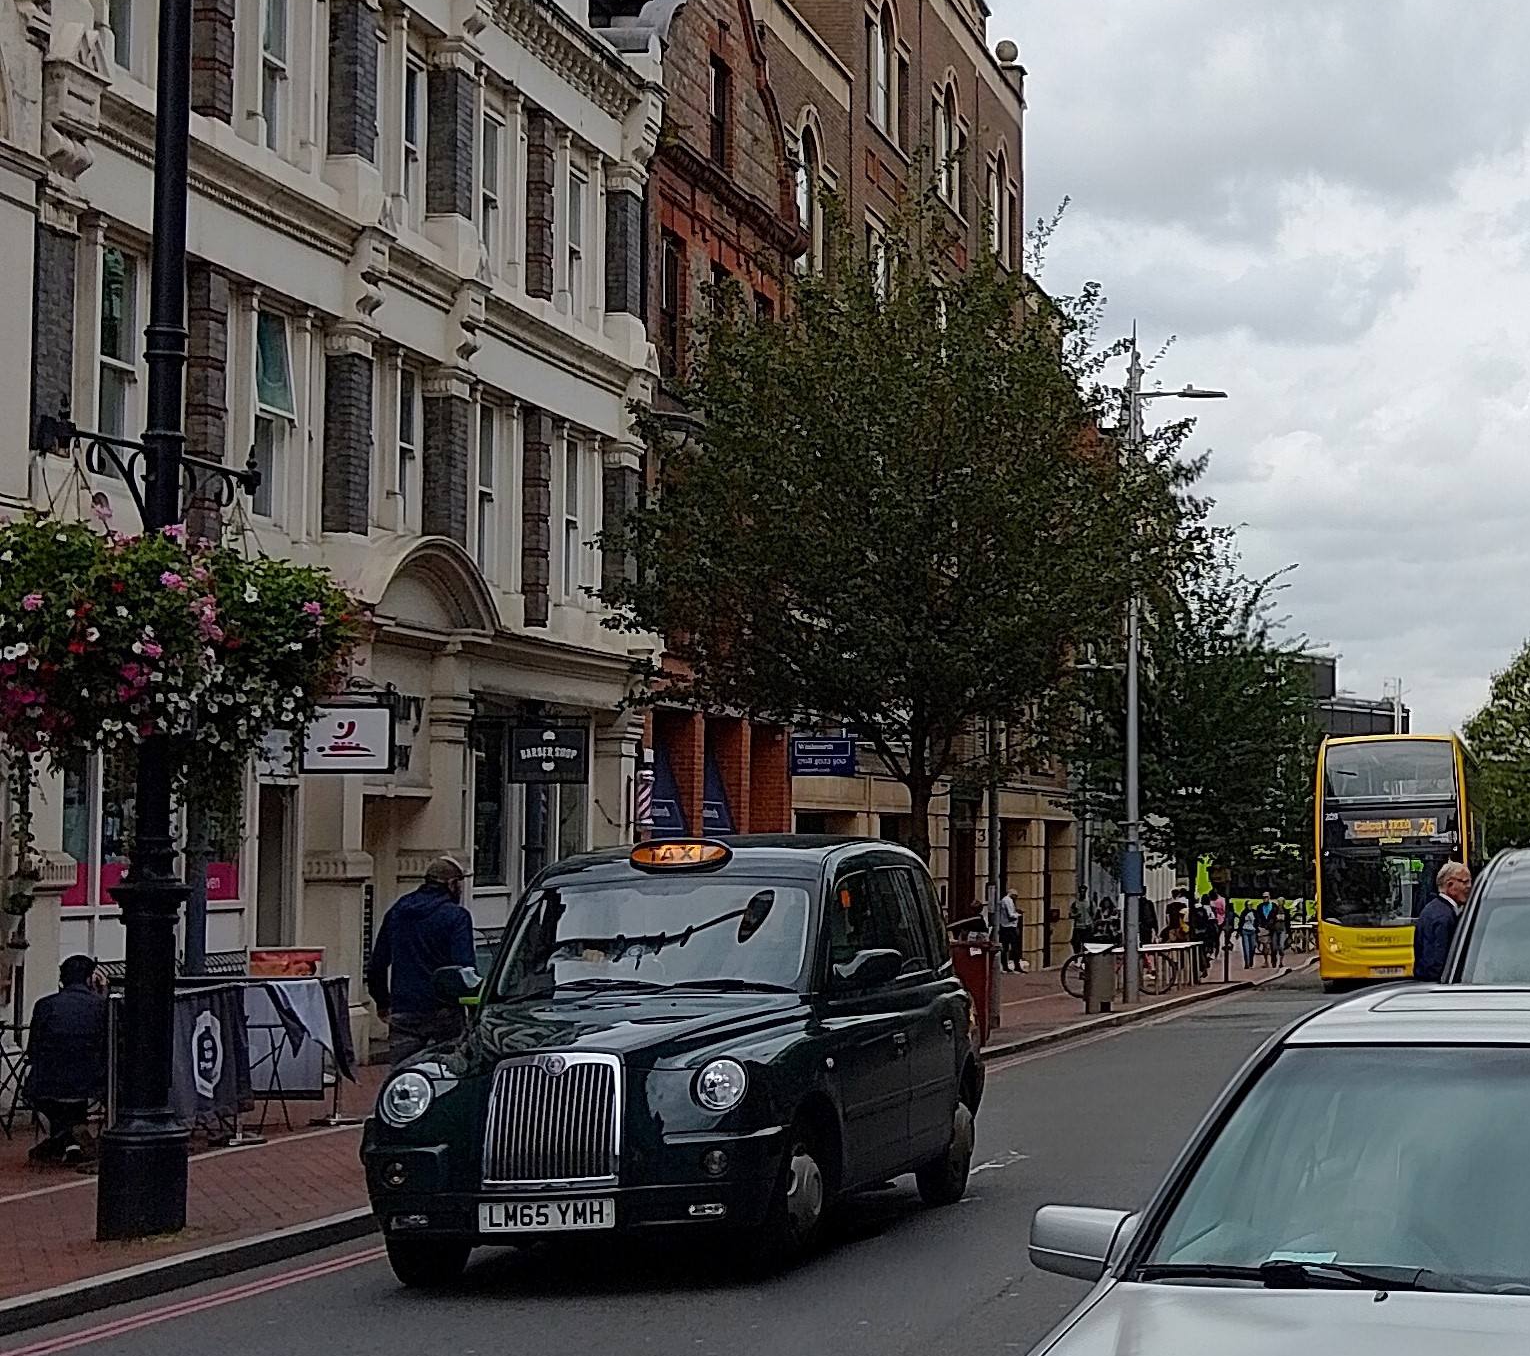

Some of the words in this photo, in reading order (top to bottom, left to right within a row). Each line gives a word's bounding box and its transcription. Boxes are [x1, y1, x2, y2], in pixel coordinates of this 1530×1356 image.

[648, 845, 704, 862] TAXI
[488, 1203, 550, 1228] LM65
[556, 1201, 604, 1225] YMH
